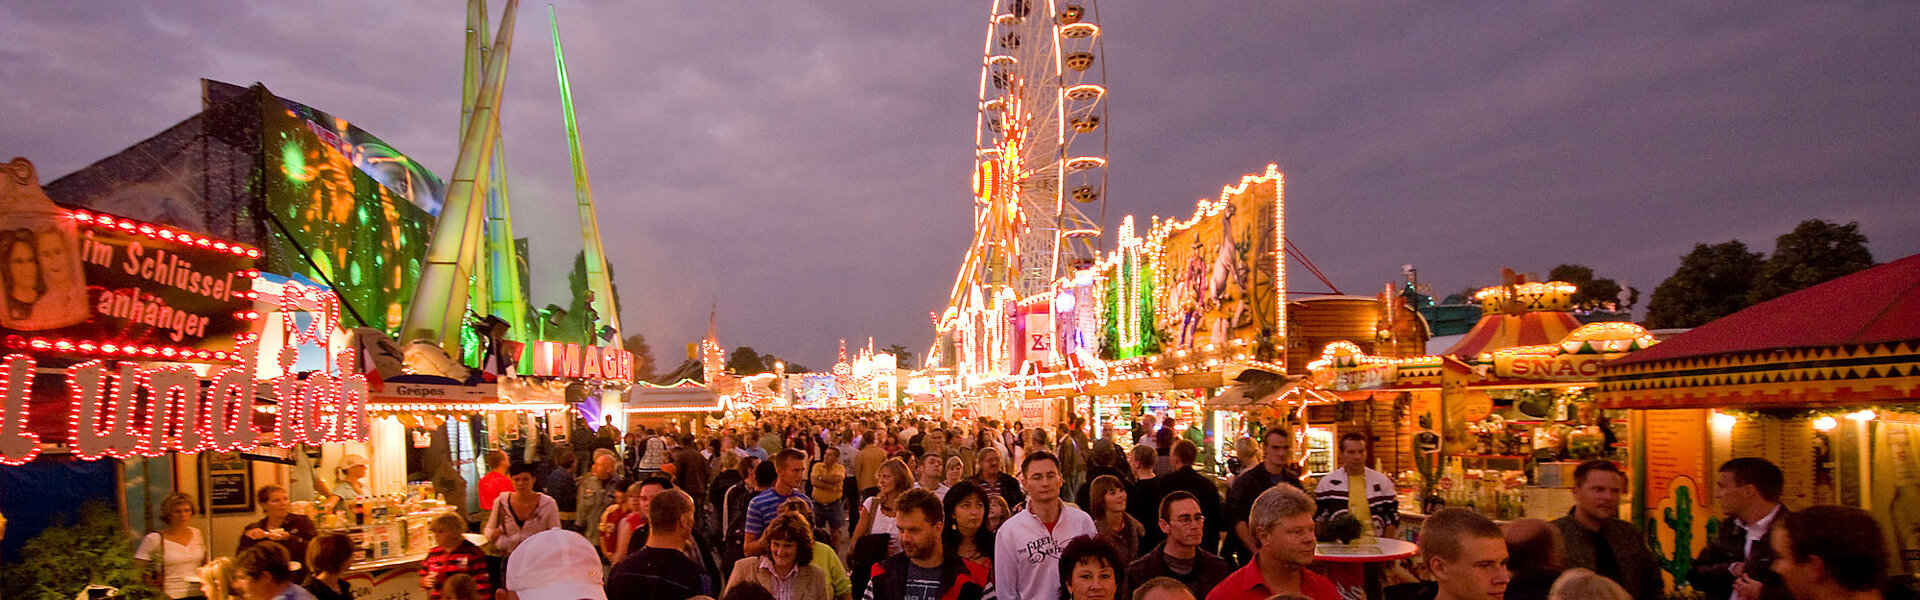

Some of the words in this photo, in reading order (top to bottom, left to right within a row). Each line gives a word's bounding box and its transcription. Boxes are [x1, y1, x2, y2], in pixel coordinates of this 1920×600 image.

[82, 230, 113, 268] im
[97, 287, 210, 342] anhänger
[1512, 359, 1598, 376] SNAC
[66, 337, 260, 461] und
[273, 344, 369, 449] ich
